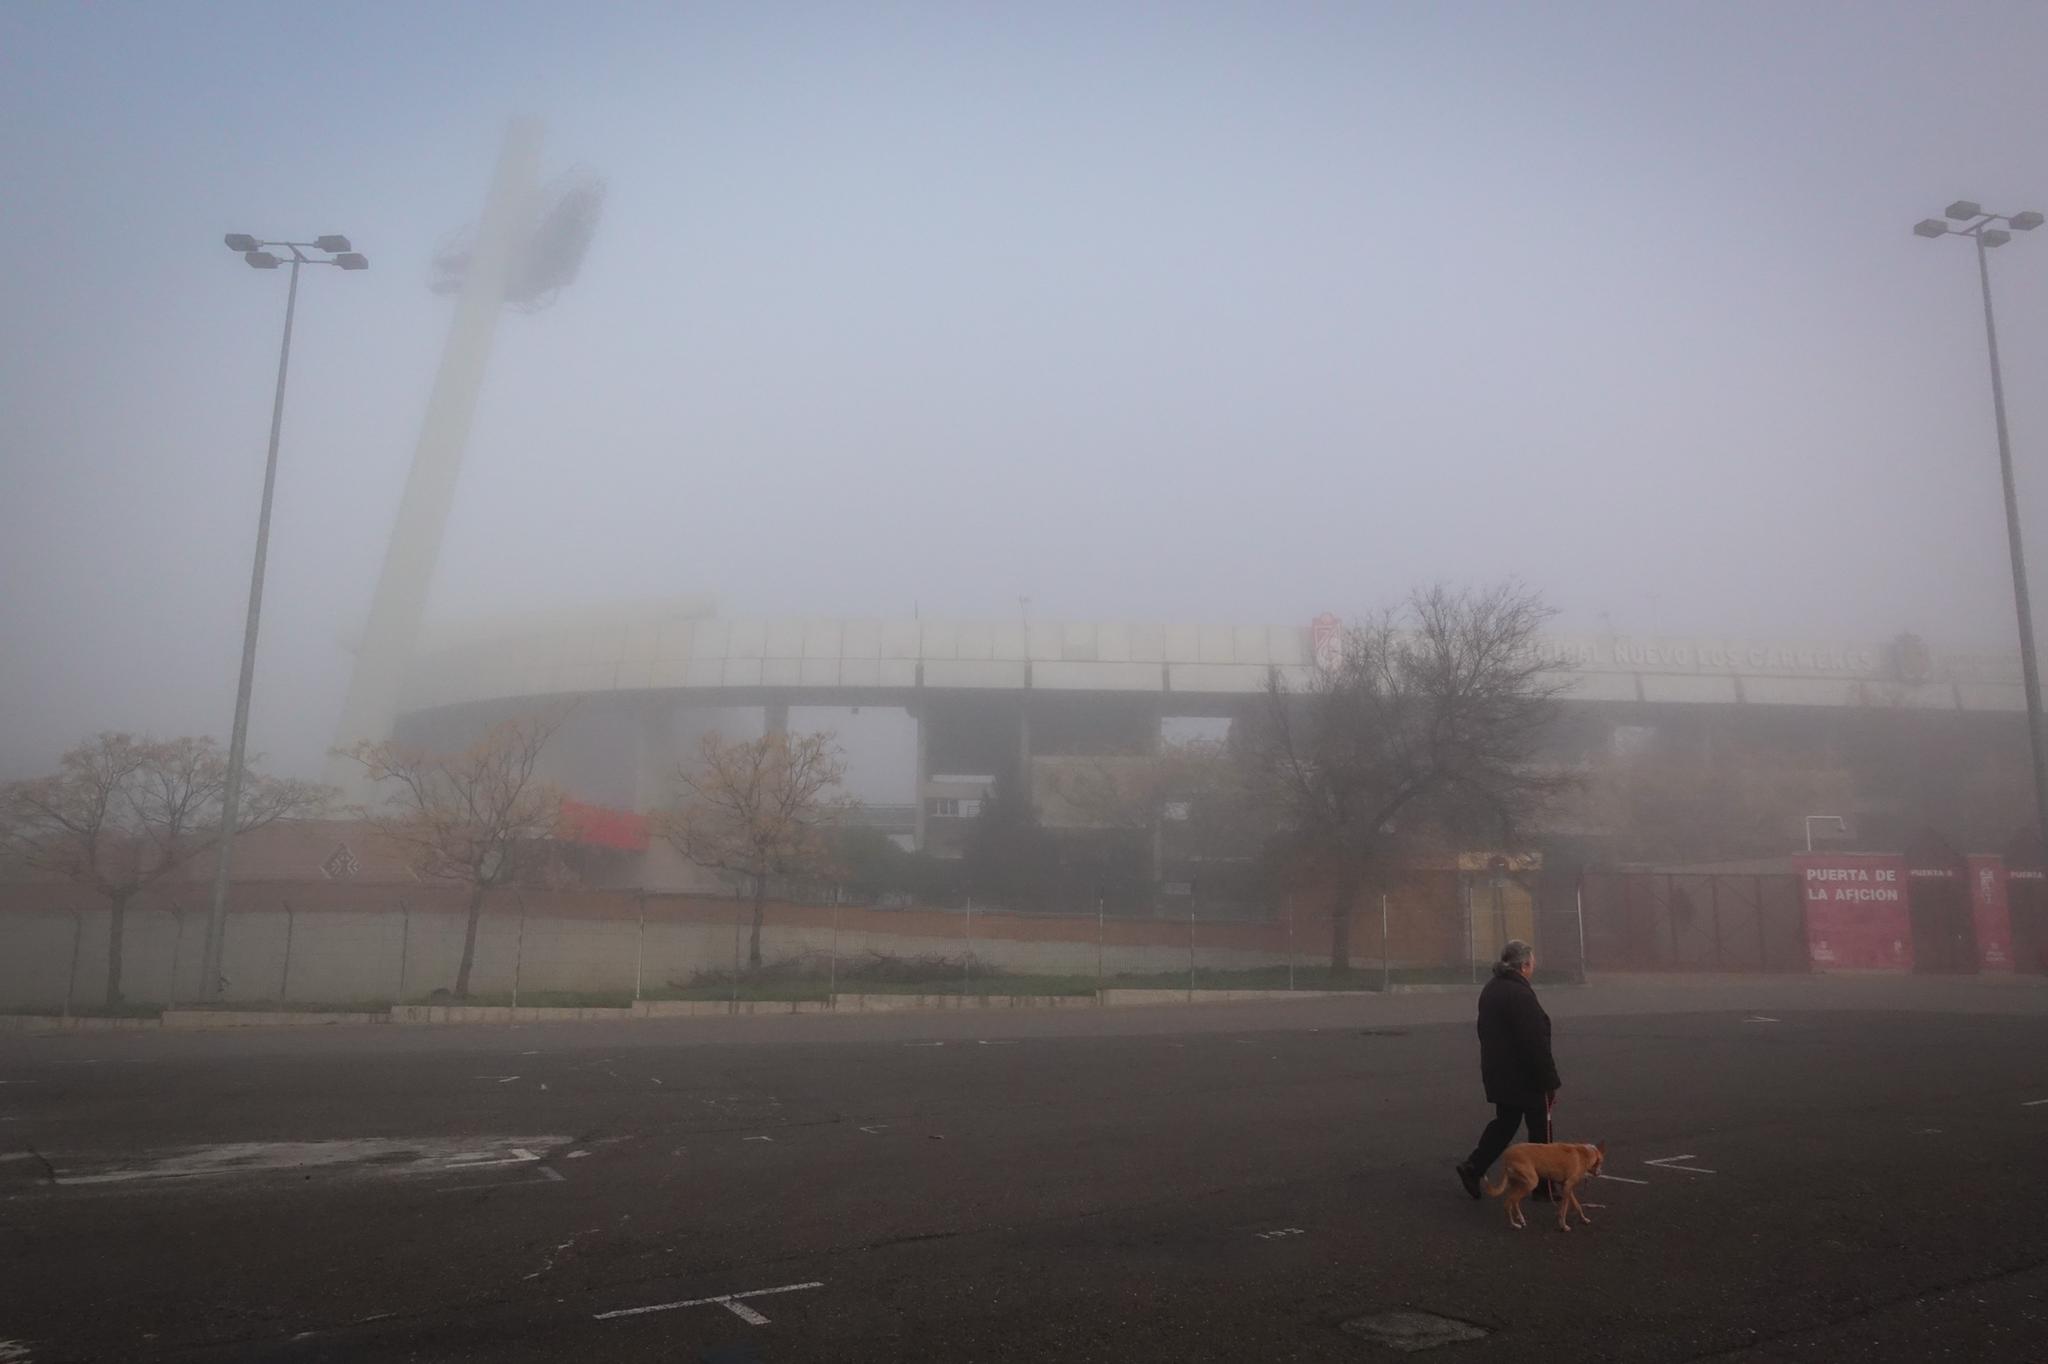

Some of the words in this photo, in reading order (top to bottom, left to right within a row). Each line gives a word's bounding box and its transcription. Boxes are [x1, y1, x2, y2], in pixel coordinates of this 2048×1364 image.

[1613, 643, 1688, 666] NUEVO
[1698, 646, 1740, 668] LOS
[1806, 868, 1868, 881] PUERTA
[1875, 869, 1896, 881] DE
[1808, 888, 1828, 900] LA
